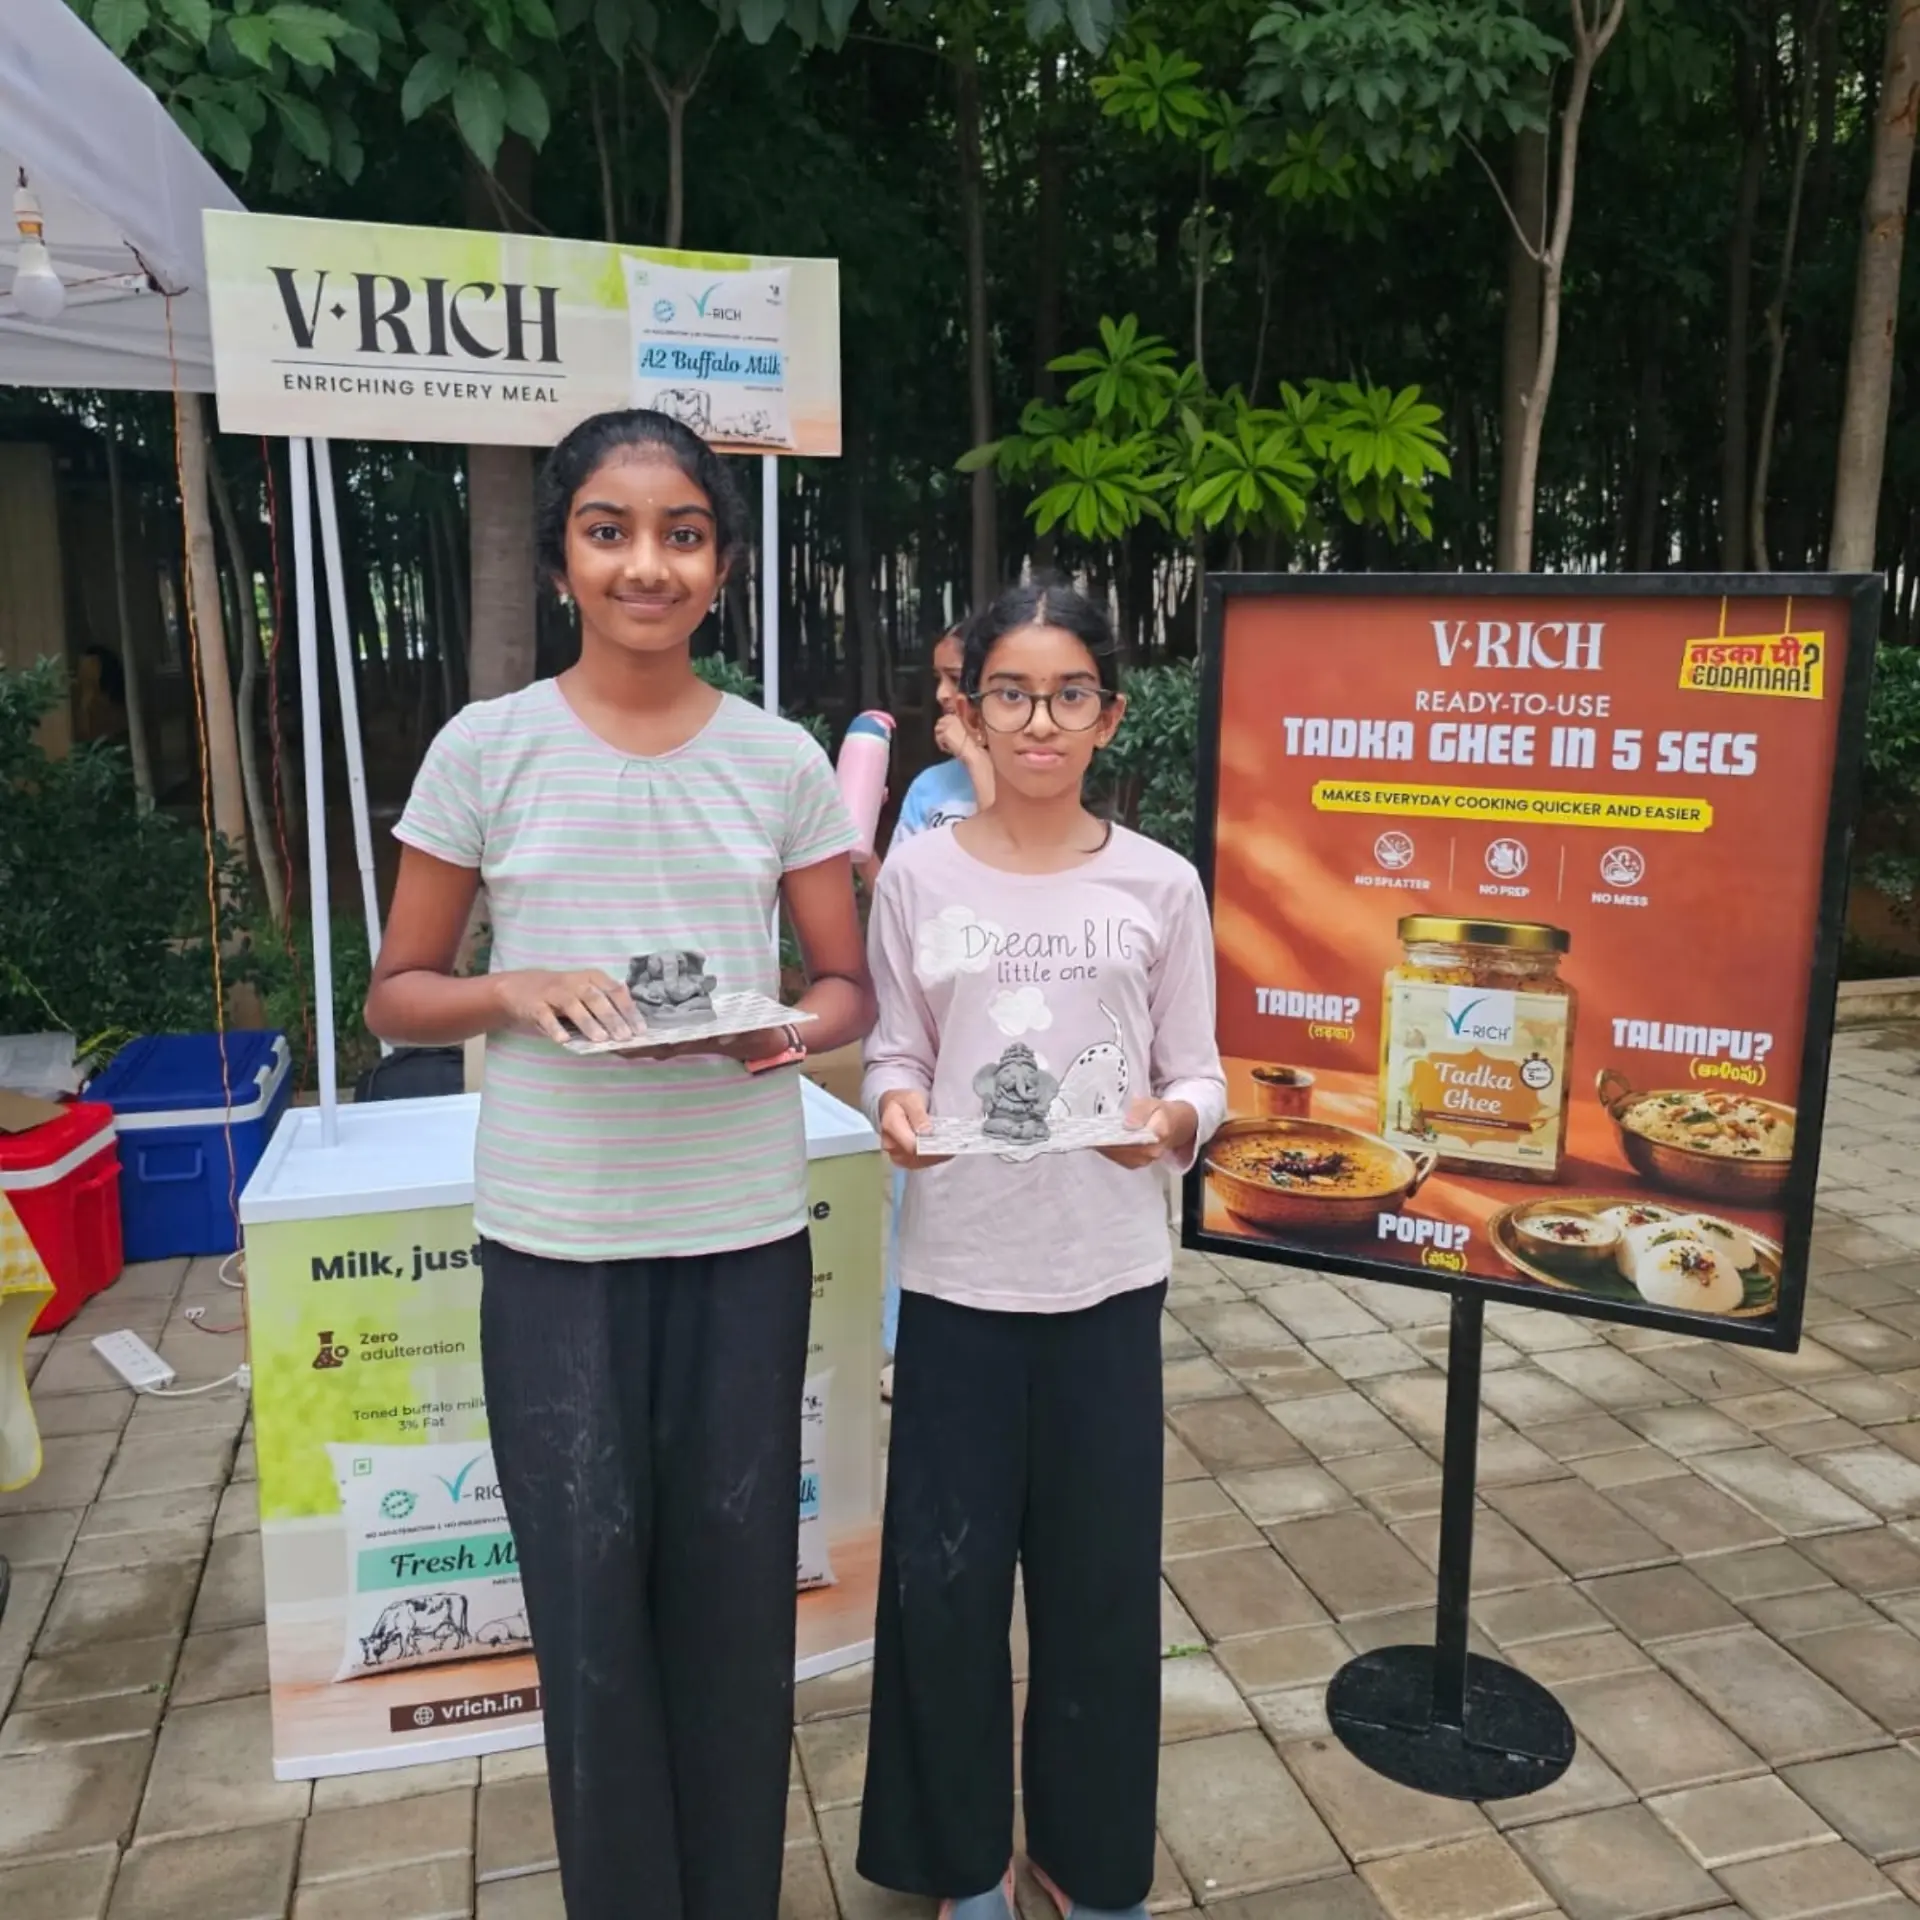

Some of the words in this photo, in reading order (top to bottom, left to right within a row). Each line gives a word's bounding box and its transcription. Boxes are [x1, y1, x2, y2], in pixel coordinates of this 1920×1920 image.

[641, 348, 667, 369] A2
[671, 350, 742, 380] Buffalo
[744, 351, 781, 376] Milk
[283, 373, 414, 396] ENRICHING
[424, 381, 492, 399] EVERY
[503, 386, 559, 402] MEAL
[1416, 690, 1611, 718] READY-TO-USE
[1283, 717, 1414, 761] TADKA
[1429, 722, 1536, 766] GHEE
[1550, 726, 1596, 769] IN
[1611, 729, 1643, 771] 5
[1656, 731, 1758, 776] SECS
[1322, 789, 1371, 803] MAKES
[1375, 792, 1451, 807] EVERYDAY
[1455, 795, 1528, 812] COOKING
[1532, 799, 1601, 815] QUICKER
[1606, 804, 1641, 817] AND
[1646, 806, 1701, 821] EASIER
[1355, 875, 1370, 886] NO
[1371, 876, 1430, 890] SPLATTER
[1480, 884, 1498, 896] NO
[1500, 885, 1530, 898] PREP
[1592, 892, 1611, 905] NO
[1614, 894, 1648, 907] MESS
[961, 924, 1077, 958] Dream
[1085, 918, 1133, 960] BIG
[997, 962, 1051, 983] little
[1060, 964, 1098, 981] one
[1256, 987, 1361, 1025] TADKA?
[1612, 1018, 1774, 1062] TALIMPU?
[1435, 1062, 1515, 1091] Tadka
[1444, 1088, 1503, 1114] Ghee
[311, 1251, 404, 1282] Milk,
[411, 1245, 483, 1282] just
[808, 1201, 830, 1220] e
[1378, 1212, 1471, 1251] POPU?
[360, 1332, 399, 1345] Zero
[360, 1341, 465, 1362] adulteration
[353, 1406, 397, 1420] Toned
[403, 1400, 453, 1415] buffalo
[398, 1420, 419, 1432] 3%
[424, 1417, 445, 1428] Fat
[391, 1544, 476, 1578] Fresh
[441, 1693, 523, 1720] vrich.in
